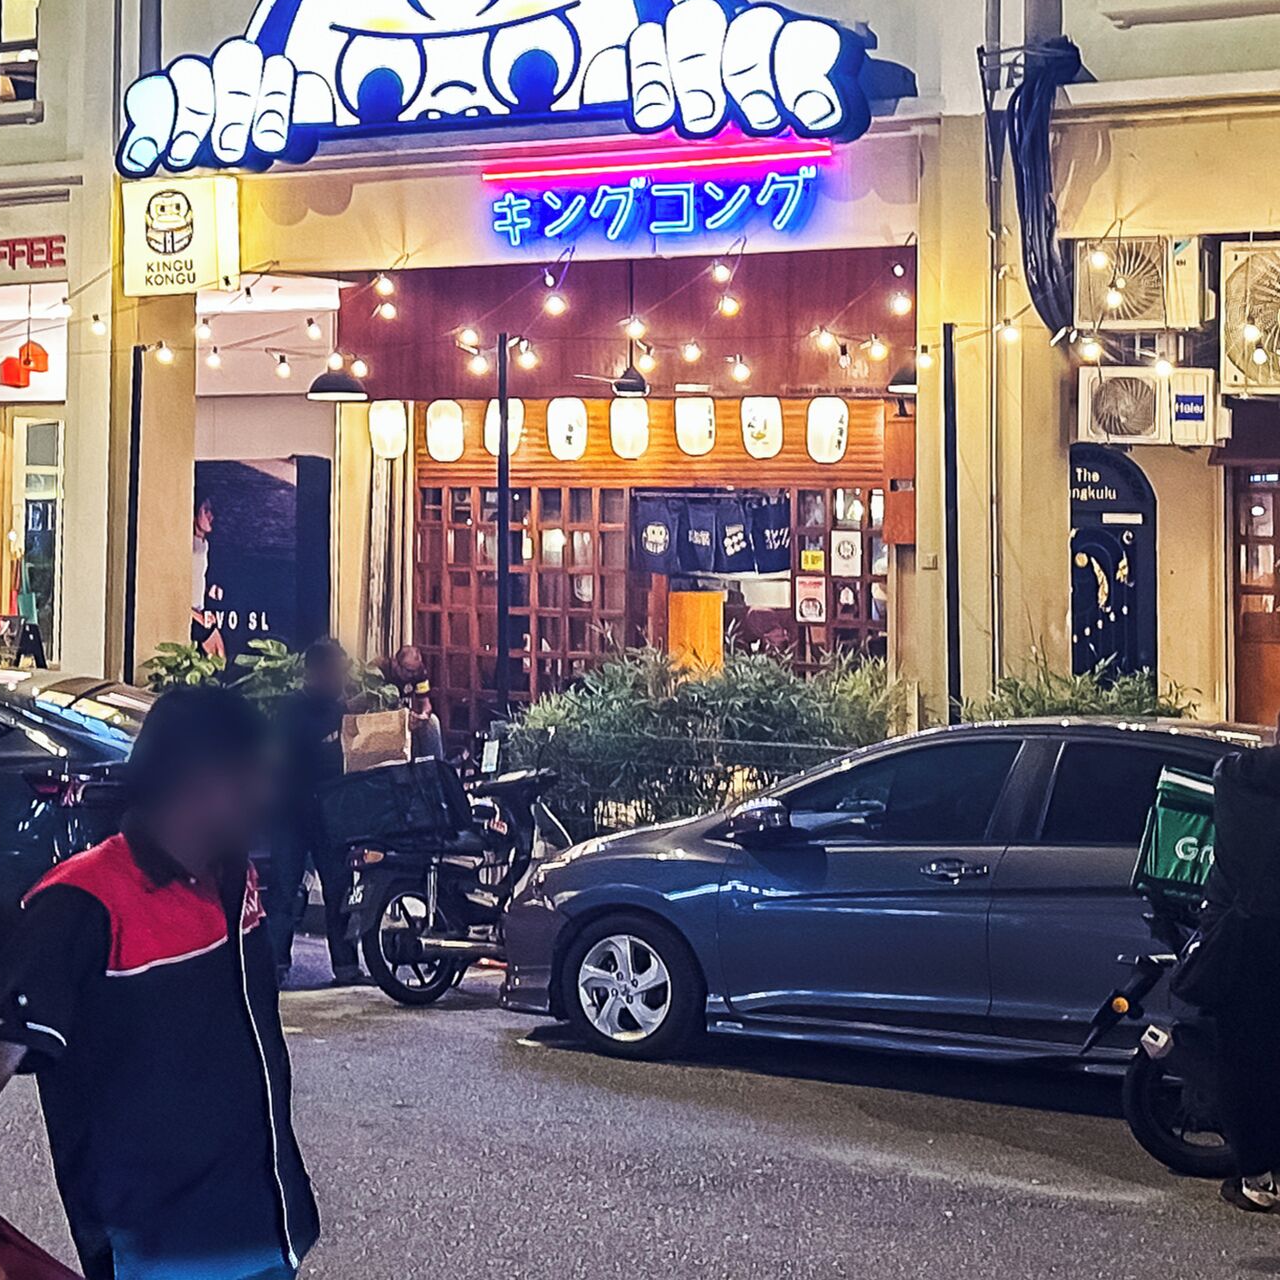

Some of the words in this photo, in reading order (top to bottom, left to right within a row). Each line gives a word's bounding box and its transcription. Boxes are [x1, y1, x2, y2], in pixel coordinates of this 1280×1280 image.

[493, 165, 817, 246] キングコング
[146, 259, 193, 273] KINGU
[145, 272, 196, 286] KONGU
[1075, 467, 1100, 483] The
[1071, 485, 1117, 501] ngkulu
[204, 610, 238, 630] EVO
[248, 611, 269, 631] SL
